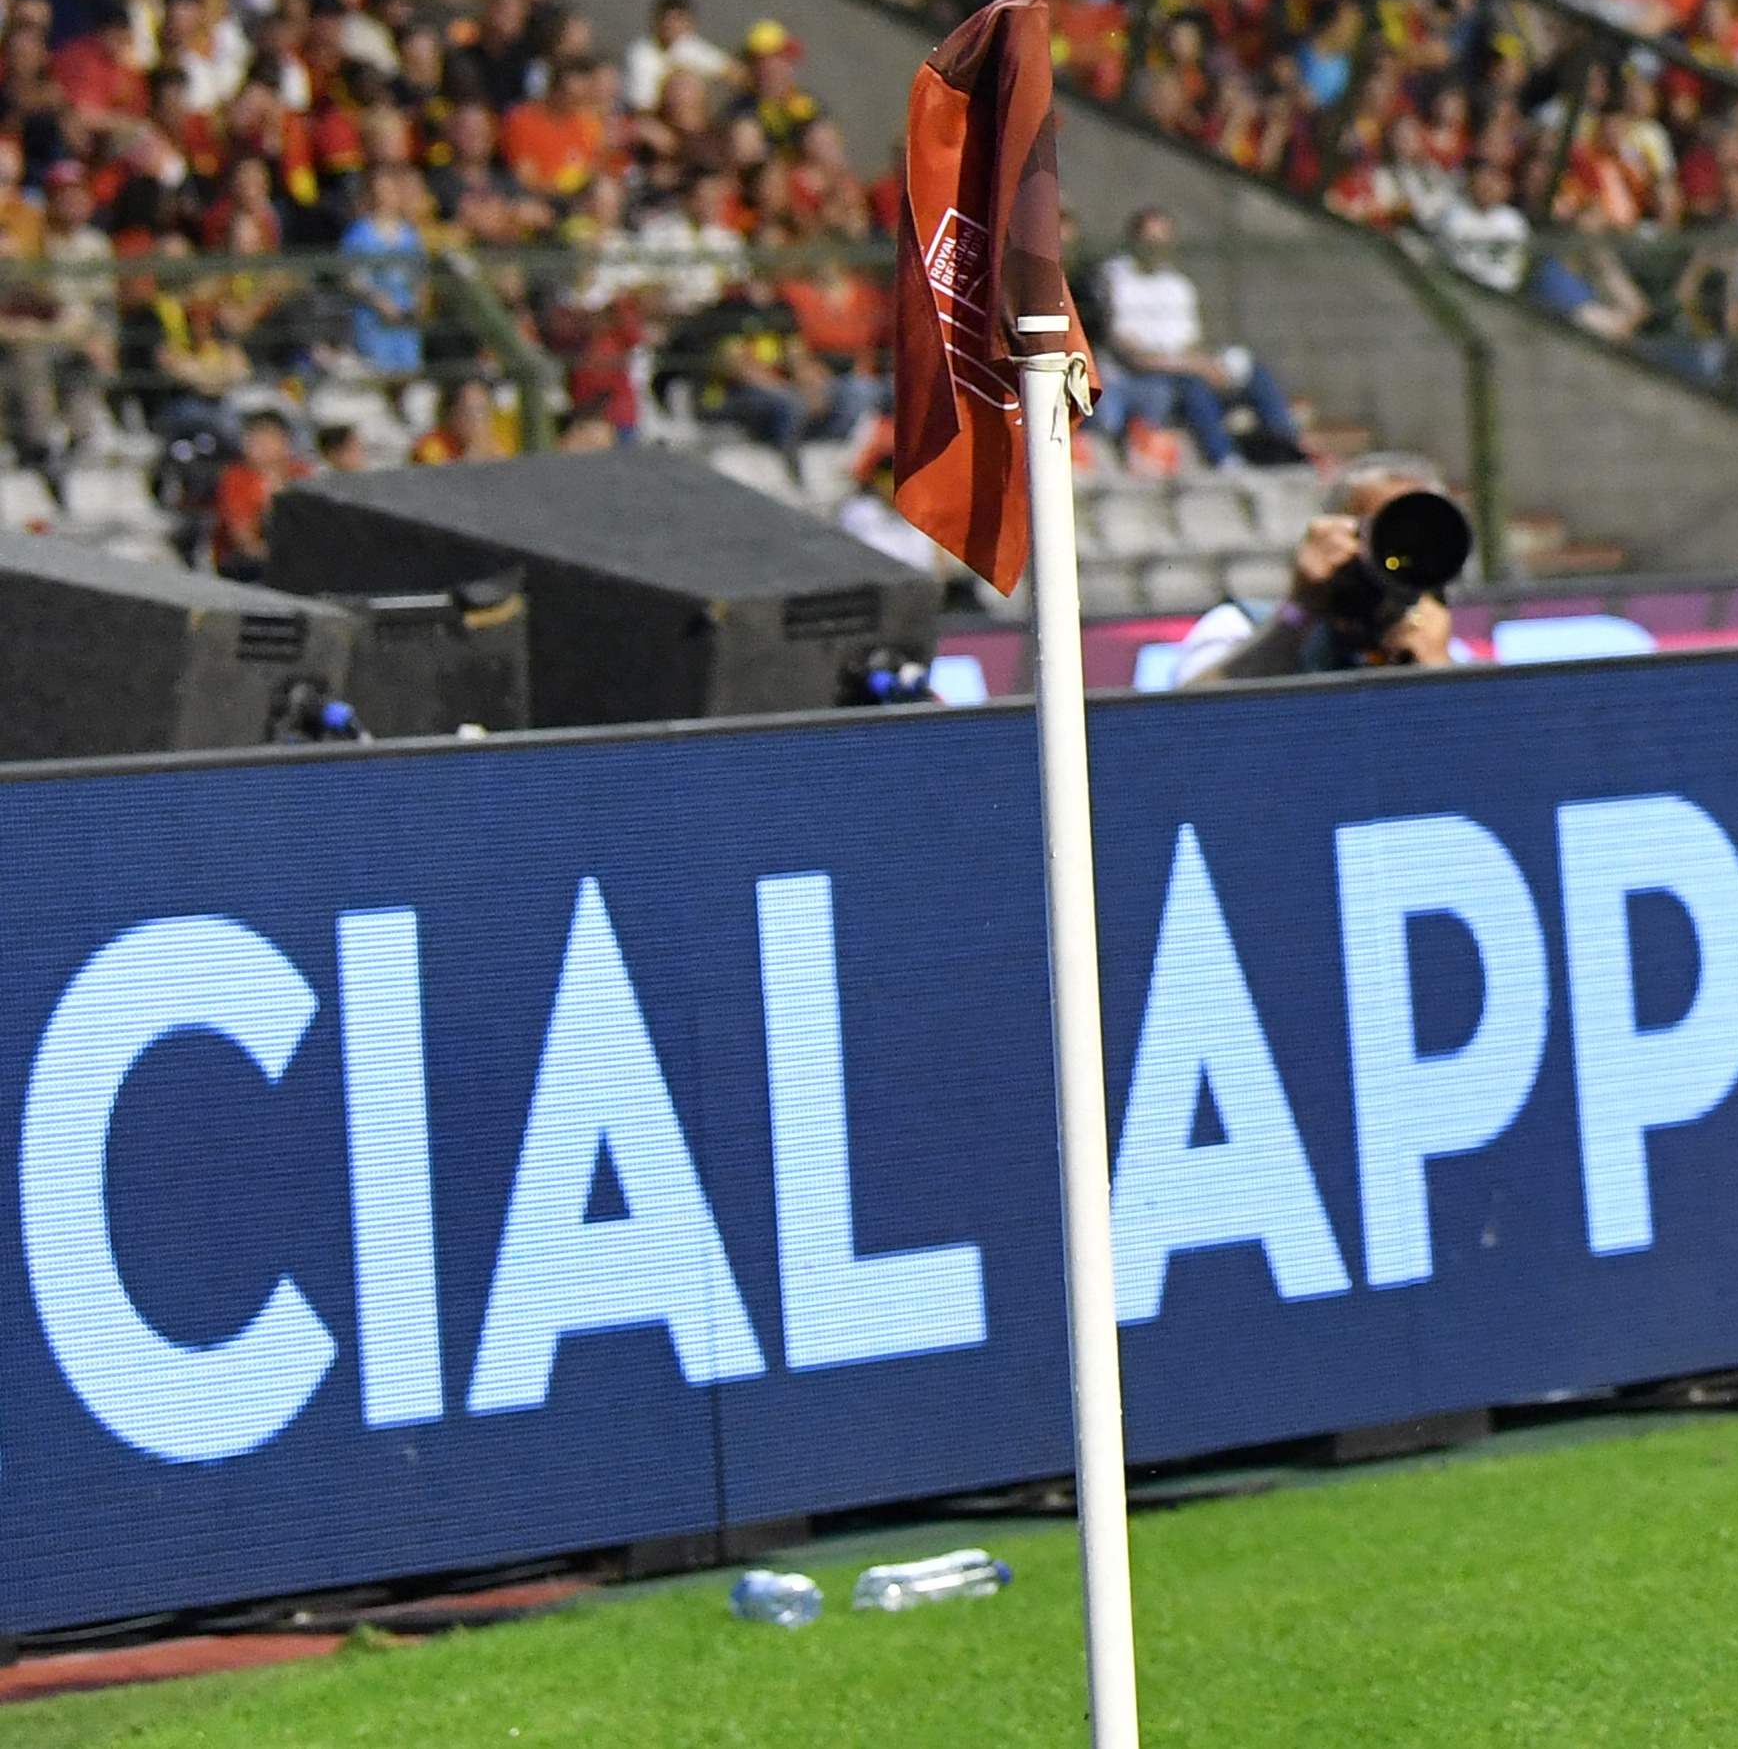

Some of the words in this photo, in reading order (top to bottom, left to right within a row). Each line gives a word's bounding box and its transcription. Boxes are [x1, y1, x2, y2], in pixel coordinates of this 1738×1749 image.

[929, 236, 957, 281] ROYAL
[941, 227, 976, 286] BELGIAN
[18, 872, 988, 1465] CIAL
